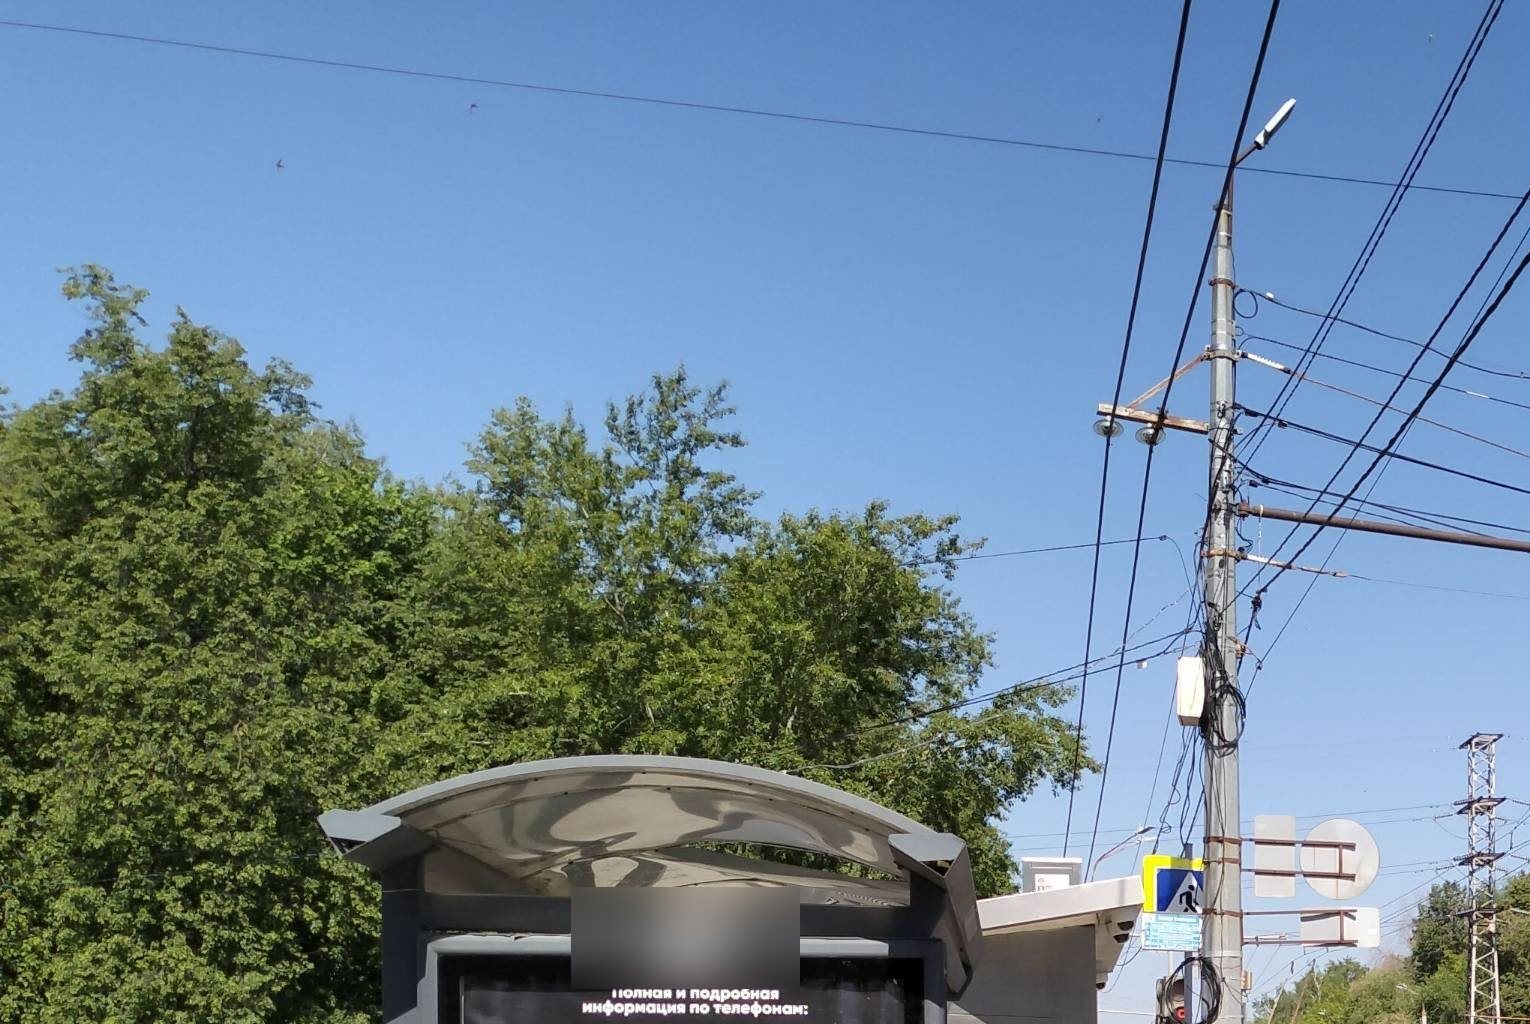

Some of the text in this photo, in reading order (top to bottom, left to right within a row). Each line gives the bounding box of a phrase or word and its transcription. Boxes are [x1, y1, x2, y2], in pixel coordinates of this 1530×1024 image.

[675, 988, 687, 1000] и
[689, 988, 780, 1003] подробная
[581, 999, 809, 1019] информация по телефонам:
